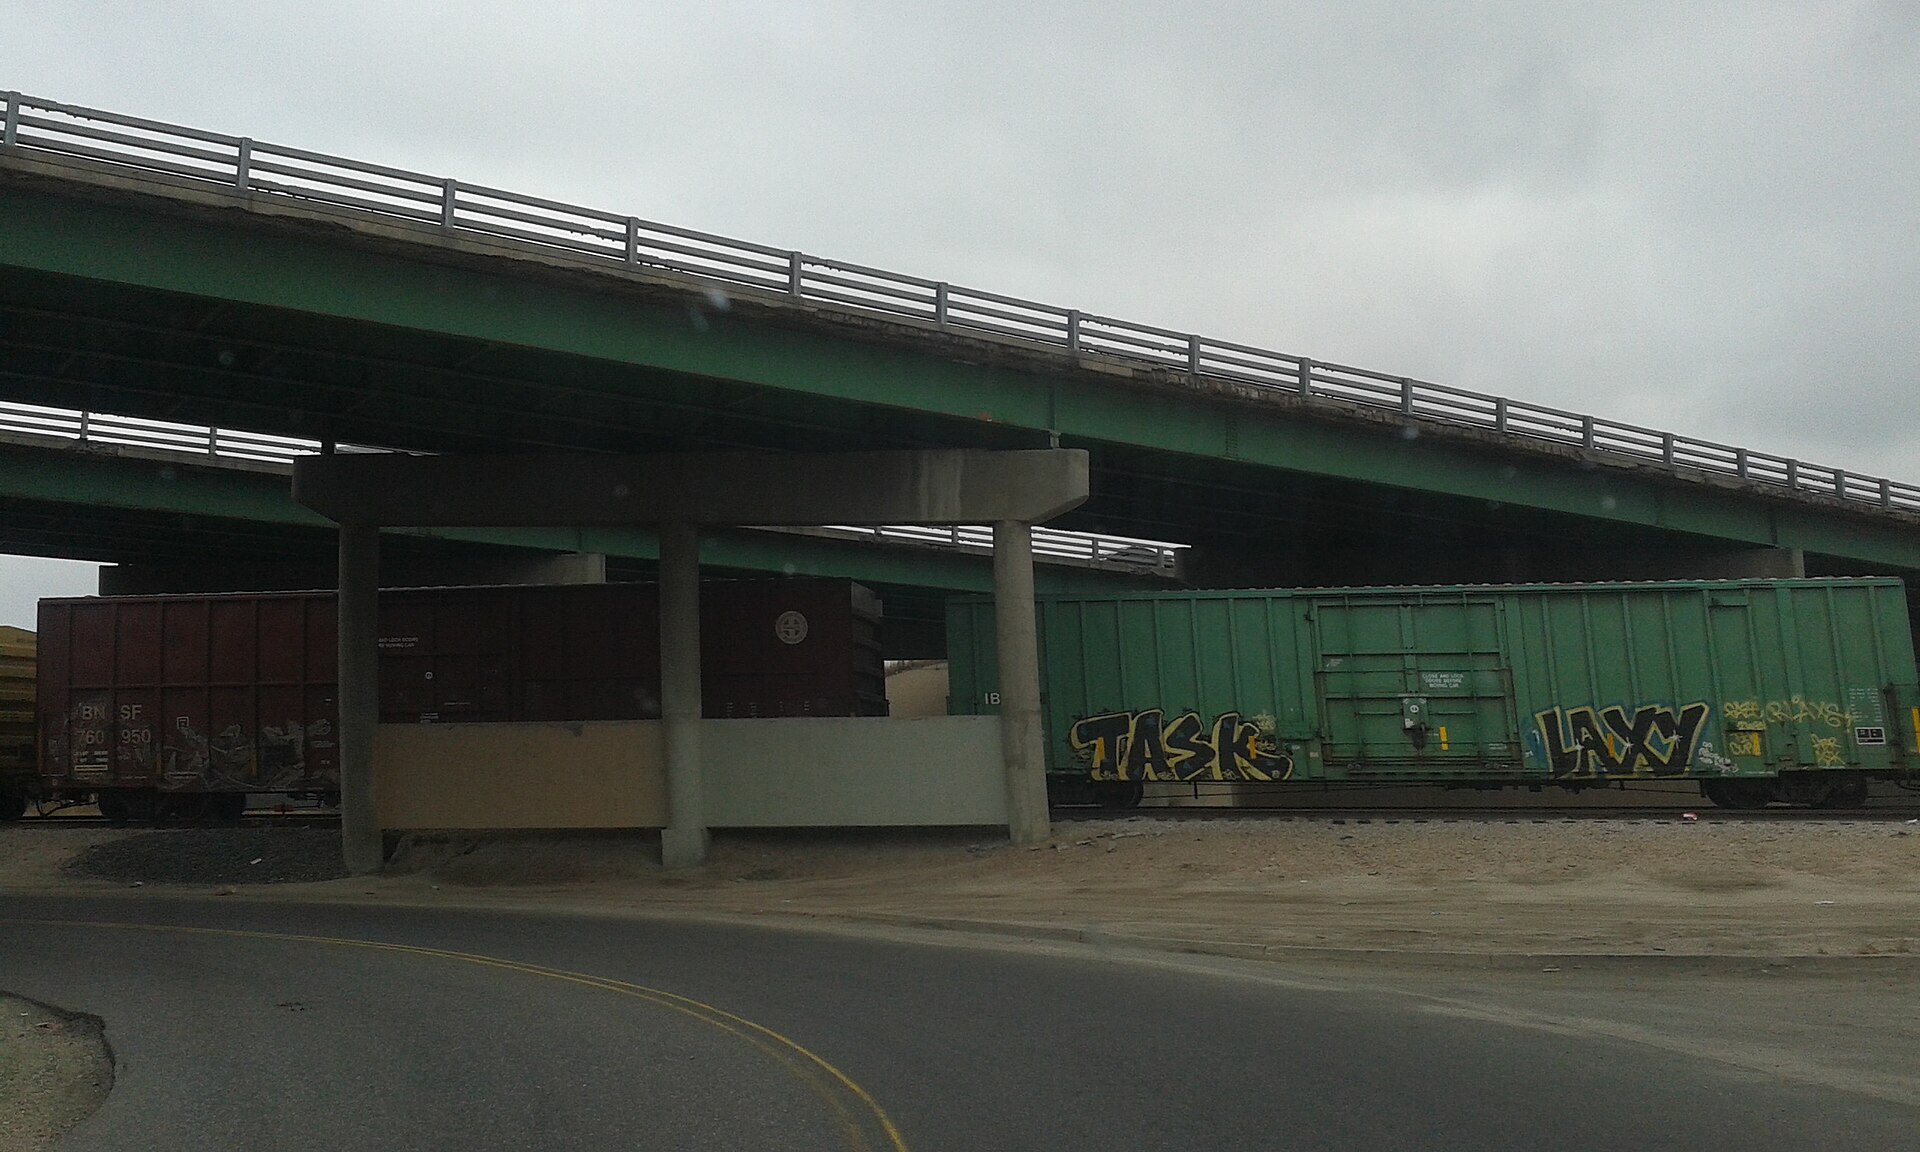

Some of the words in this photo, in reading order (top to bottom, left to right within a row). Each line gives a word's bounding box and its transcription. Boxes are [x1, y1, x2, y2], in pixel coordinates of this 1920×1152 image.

[120, 704, 142, 720] SF
[78, 729, 105, 744] 760
[121, 729, 151, 744] 950
[1070, 707, 1293, 782] TASK
